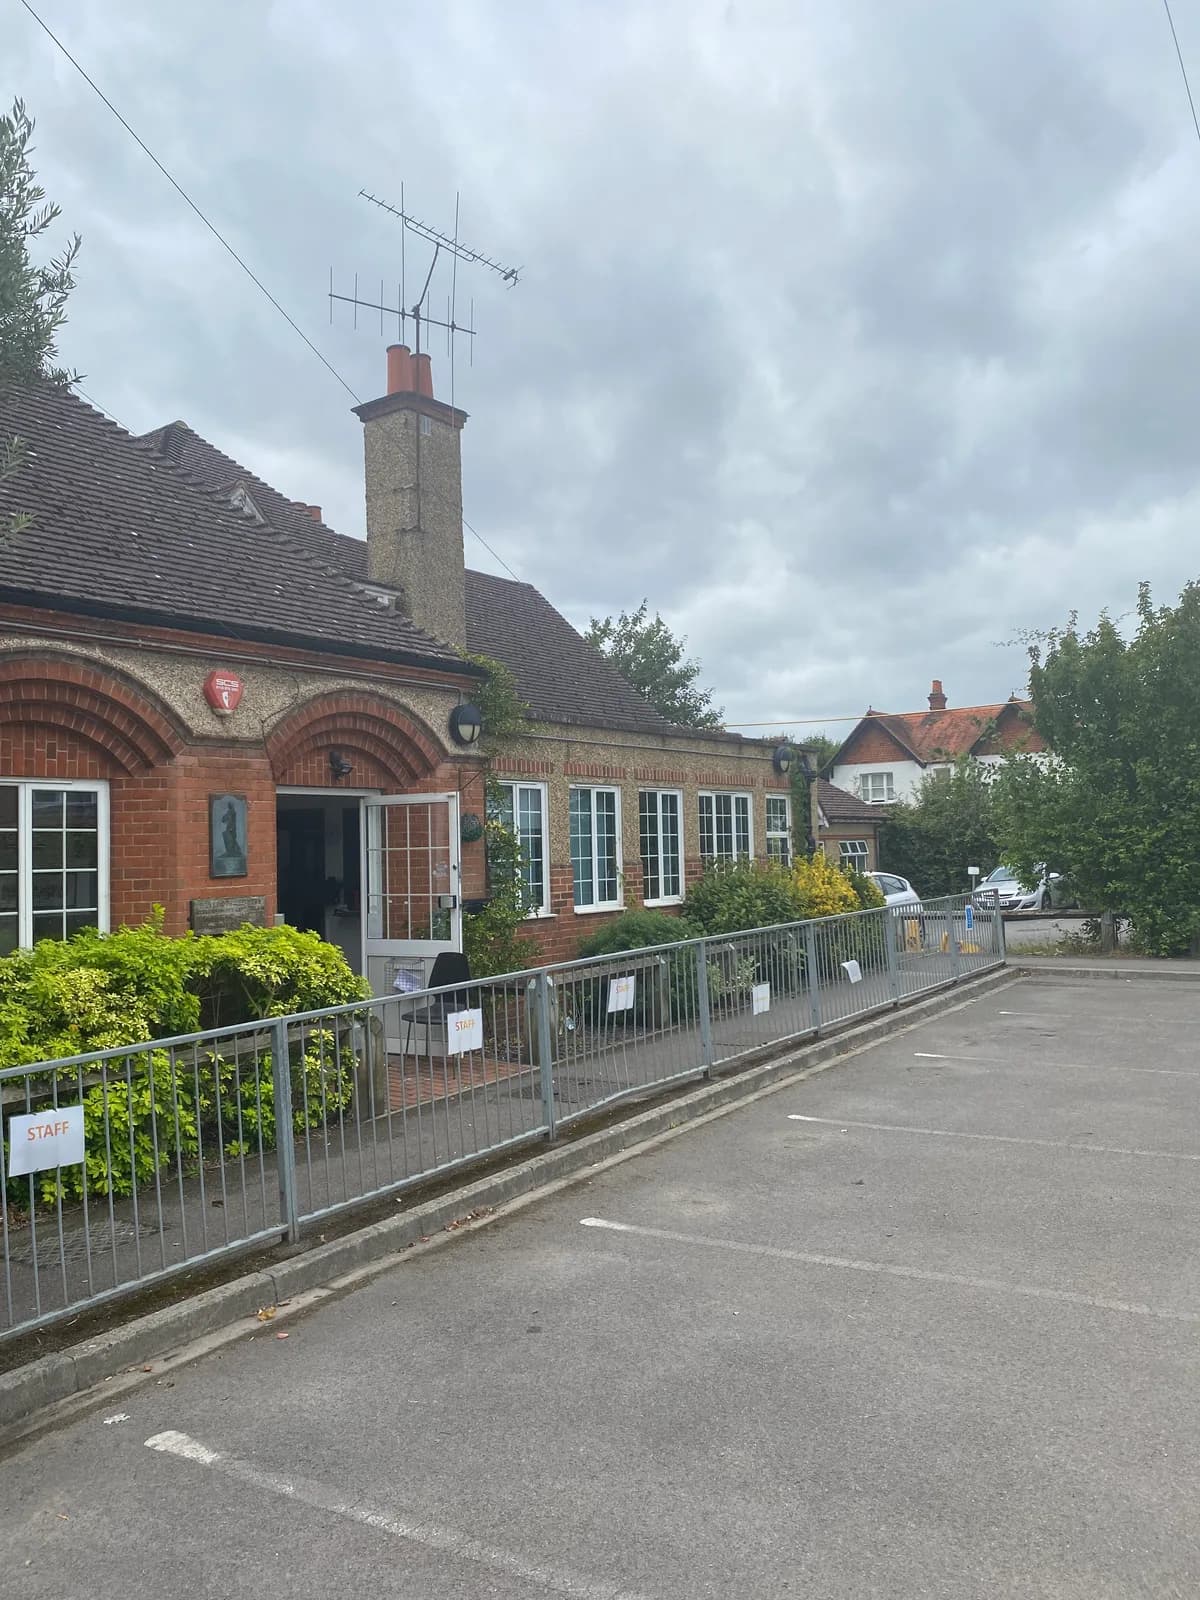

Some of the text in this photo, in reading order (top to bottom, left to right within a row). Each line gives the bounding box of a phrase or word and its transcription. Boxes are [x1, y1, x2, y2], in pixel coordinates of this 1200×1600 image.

[215, 678, 239, 688] SCS
[455, 1019, 476, 1032] STAFF
[27, 1120, 69, 1141] STAFF
